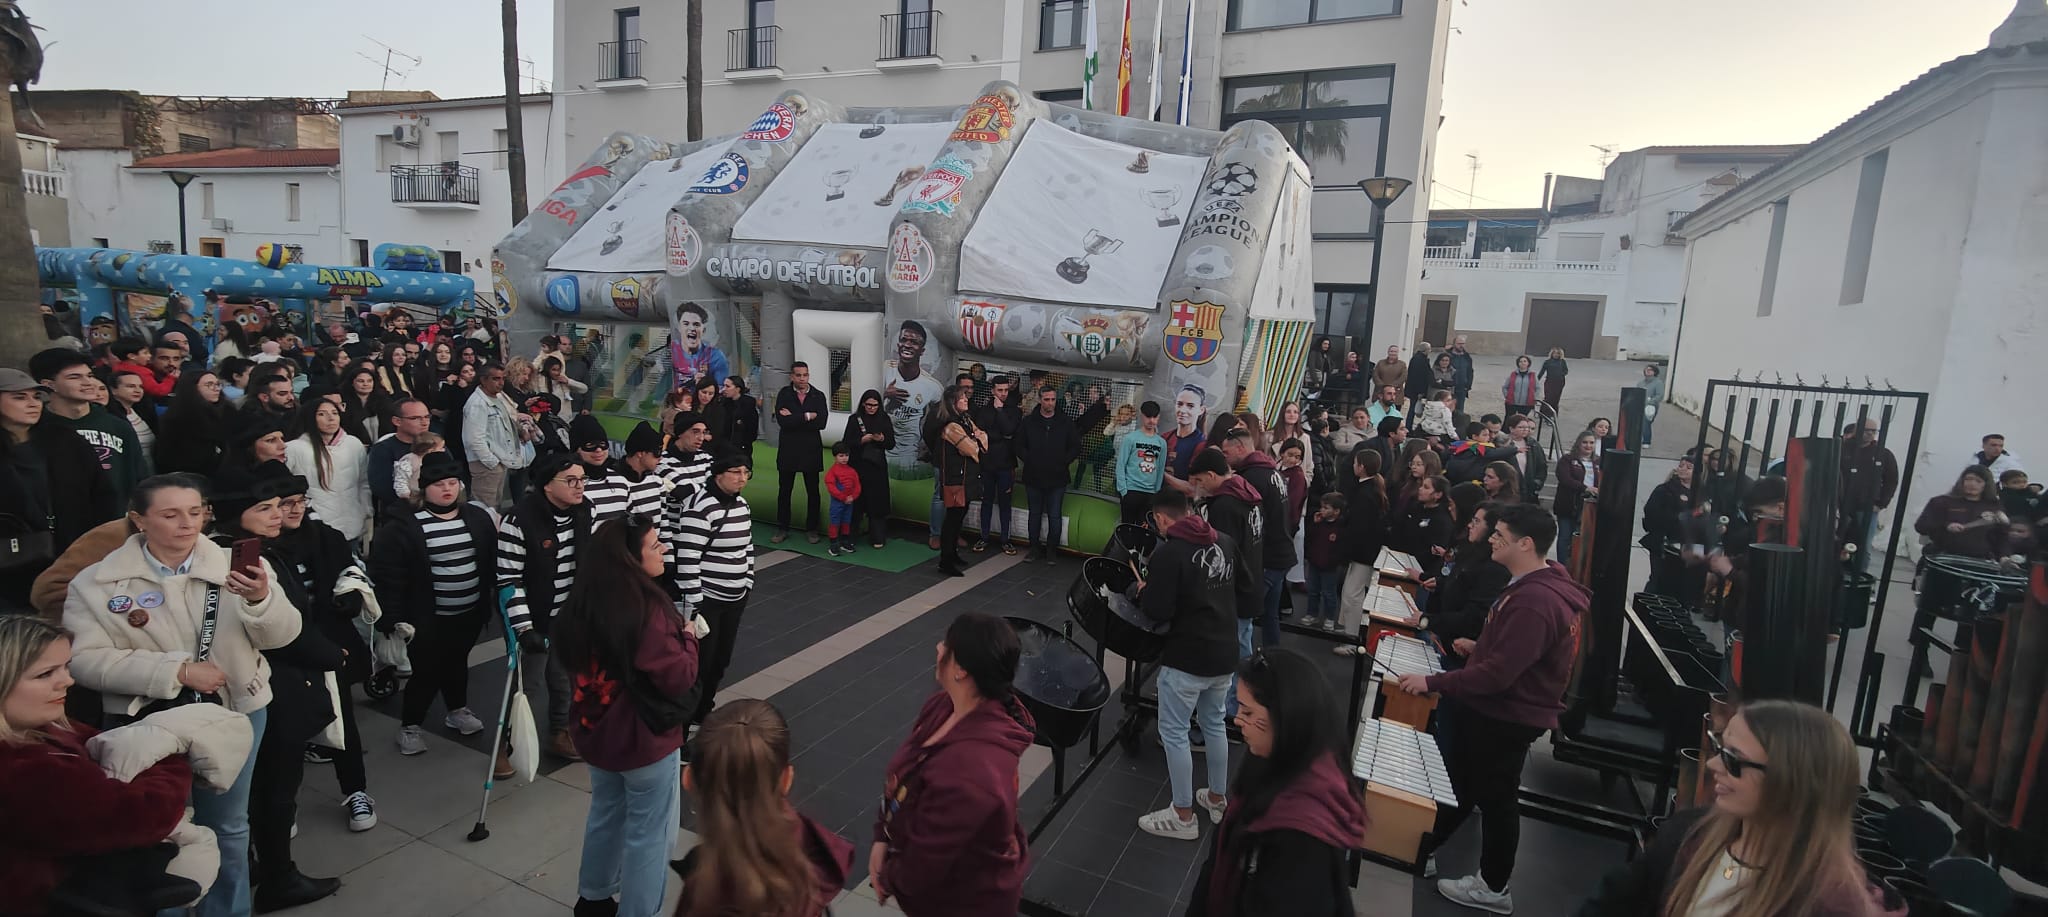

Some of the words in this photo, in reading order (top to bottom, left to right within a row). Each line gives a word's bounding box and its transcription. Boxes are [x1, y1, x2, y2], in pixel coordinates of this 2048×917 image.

[744, 131, 780, 140] CHEN
[952, 132, 988, 141] NITED
[534, 200, 577, 226] IGA
[1205, 201, 1241, 213] UEFA
[318, 268, 383, 287] ALMA
[706, 257, 773, 280] CAMPO
[777, 260, 801, 282] DE
[805, 262, 880, 289] FUTBOL
[895, 263, 918, 273] ALMA
[556, 284, 570, 306] N
[100, 431, 123, 453] PACE
[207, 589, 218, 613] LOLA
